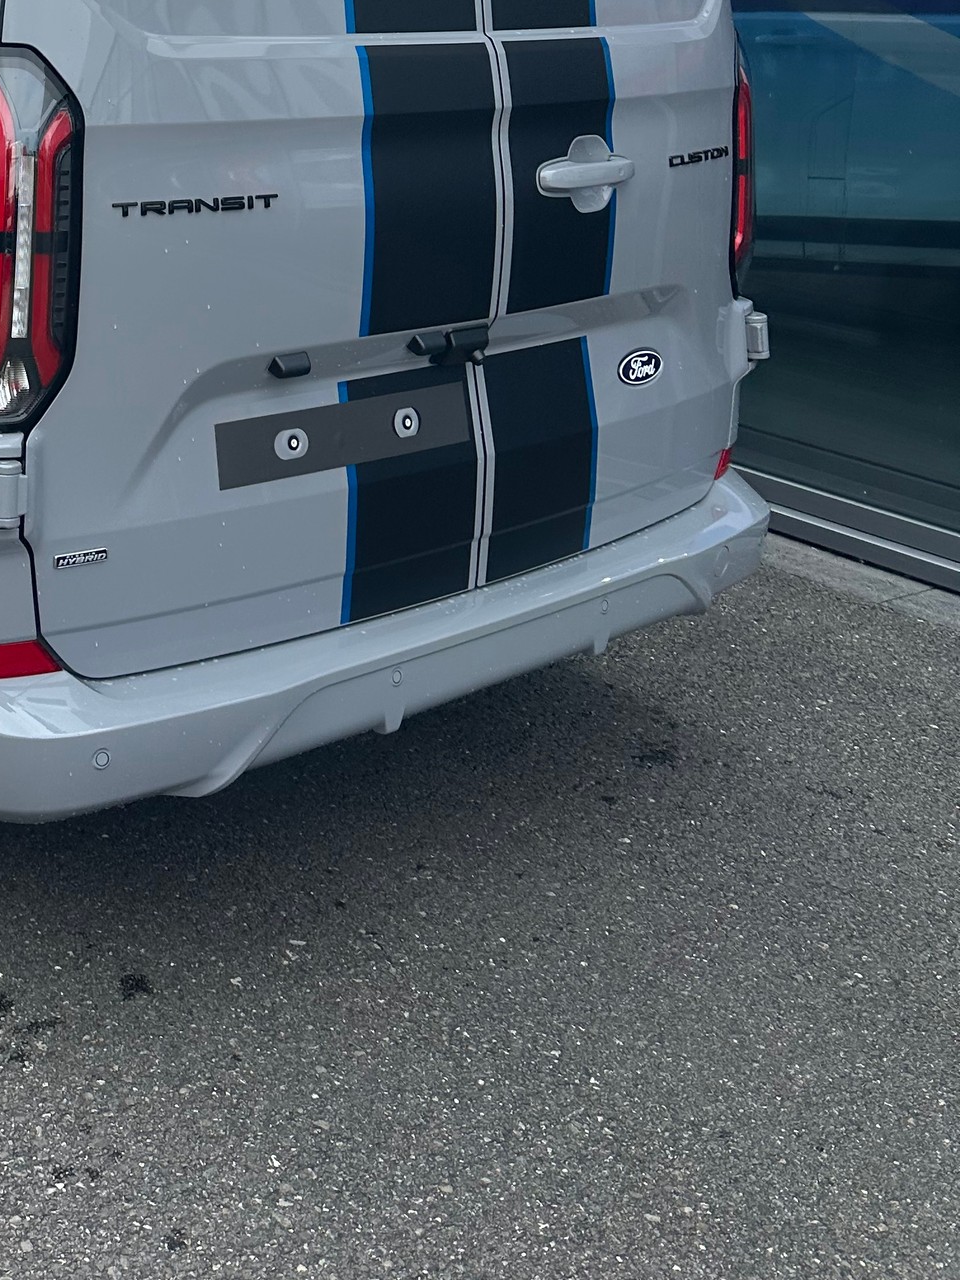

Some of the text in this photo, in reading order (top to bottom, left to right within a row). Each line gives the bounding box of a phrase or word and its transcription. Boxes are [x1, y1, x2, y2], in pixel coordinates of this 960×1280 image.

[669, 145, 729, 167] CUSTOM
[112, 194, 279, 217] TRANSIT
[629, 355, 656, 380] Ford
[58, 552, 107, 567] HYBRID
